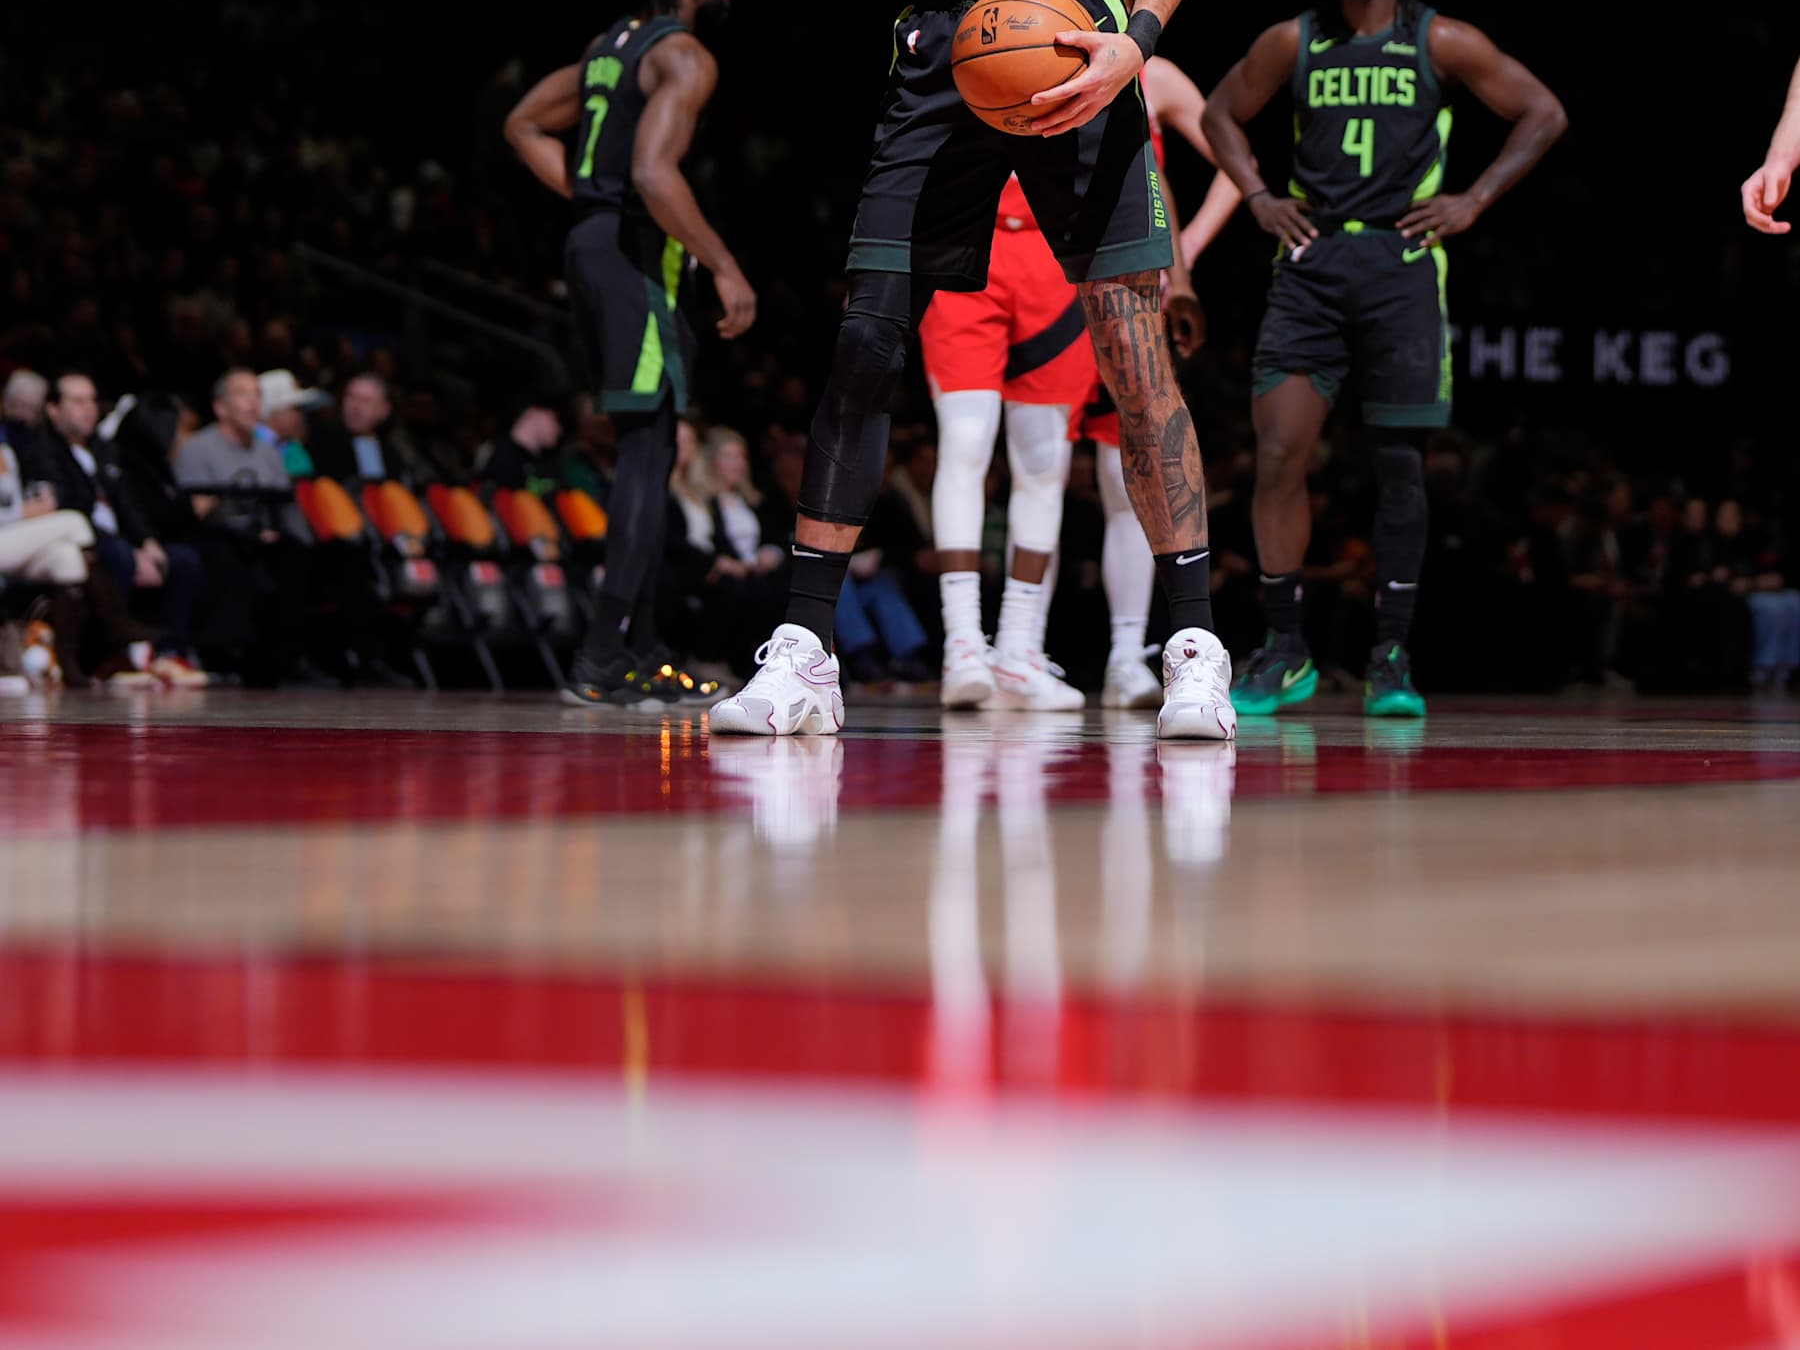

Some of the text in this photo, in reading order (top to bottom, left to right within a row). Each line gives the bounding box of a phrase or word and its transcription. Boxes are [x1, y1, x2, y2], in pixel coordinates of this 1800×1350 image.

[1308, 65, 1417, 108] CELTICS
[577, 94, 609, 178] 7
[1341, 117, 1375, 179] 4
[1149, 170, 1167, 228] BOSTON
[1593, 330, 1730, 386] KEG
